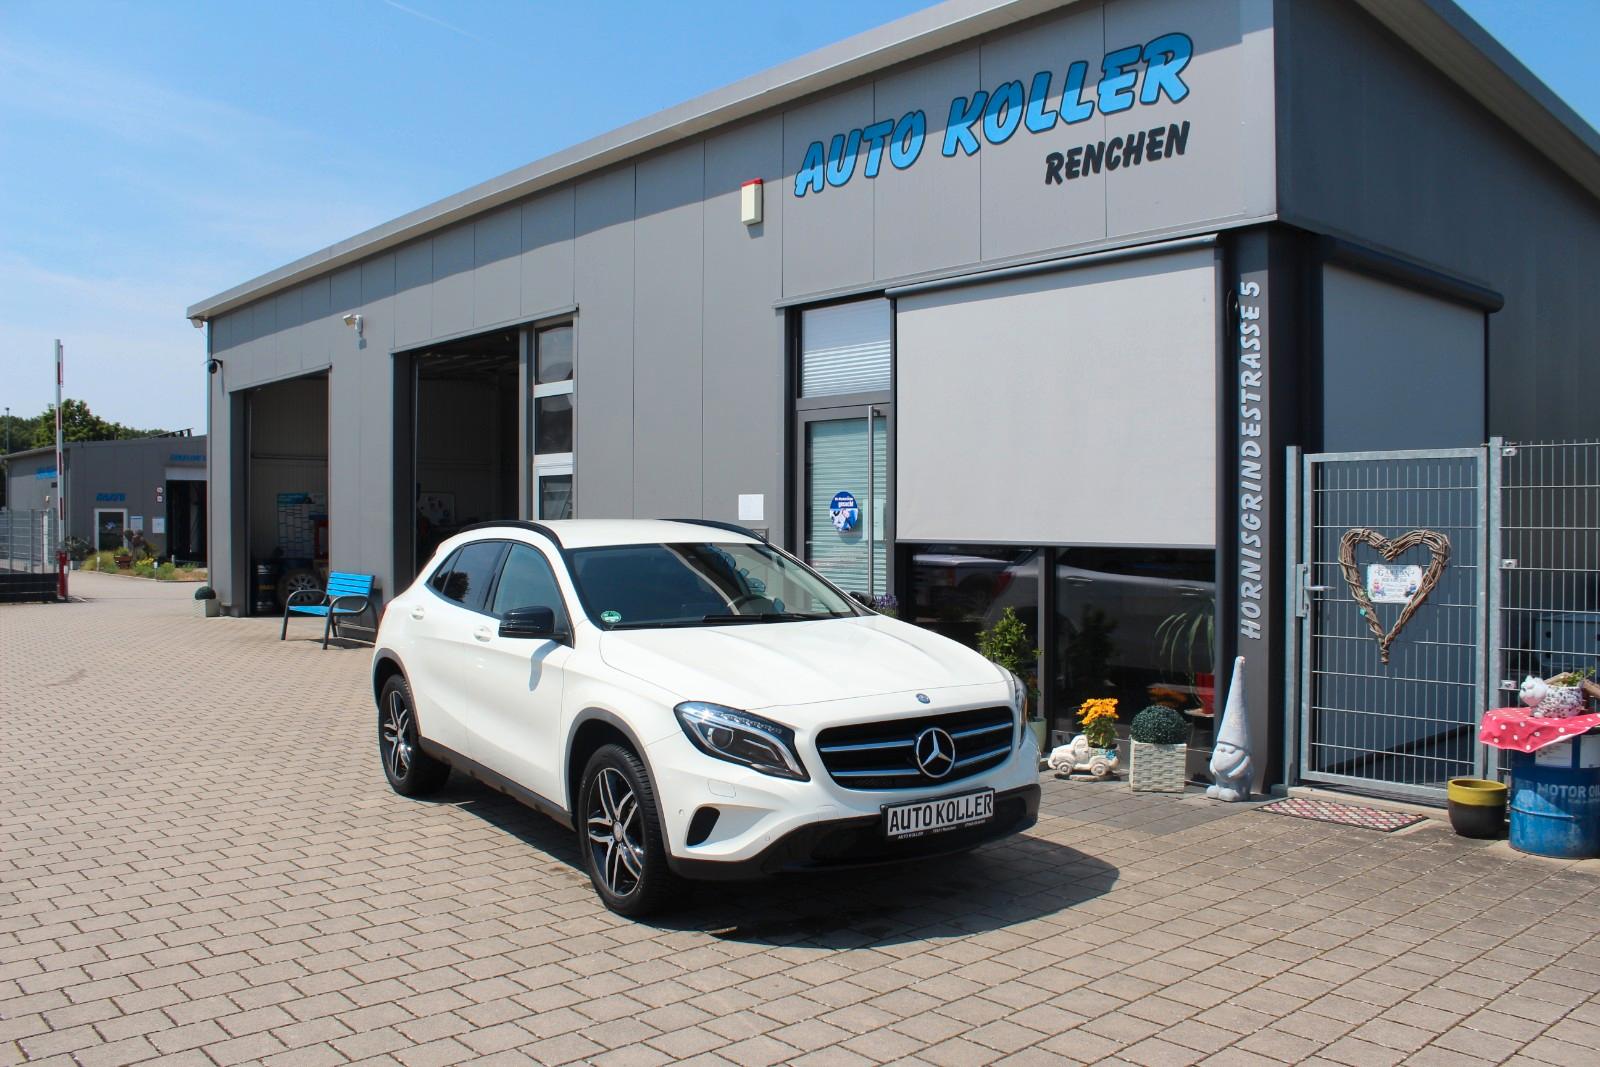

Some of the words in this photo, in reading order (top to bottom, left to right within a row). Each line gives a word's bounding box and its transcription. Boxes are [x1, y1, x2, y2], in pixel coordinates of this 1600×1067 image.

[794, 109, 926, 197] AUTO
[941, 32, 1193, 157] KOLLER
[1045, 120, 1191, 185] RENCHEN
[1240, 281, 1260, 297] 5
[1240, 305, 1263, 640] HORNISGRINDESTRASSE
[889, 804, 932, 832] AUTO
[936, 793, 992, 824] KOLLER
[1537, 782, 1586, 799] MOTOR
